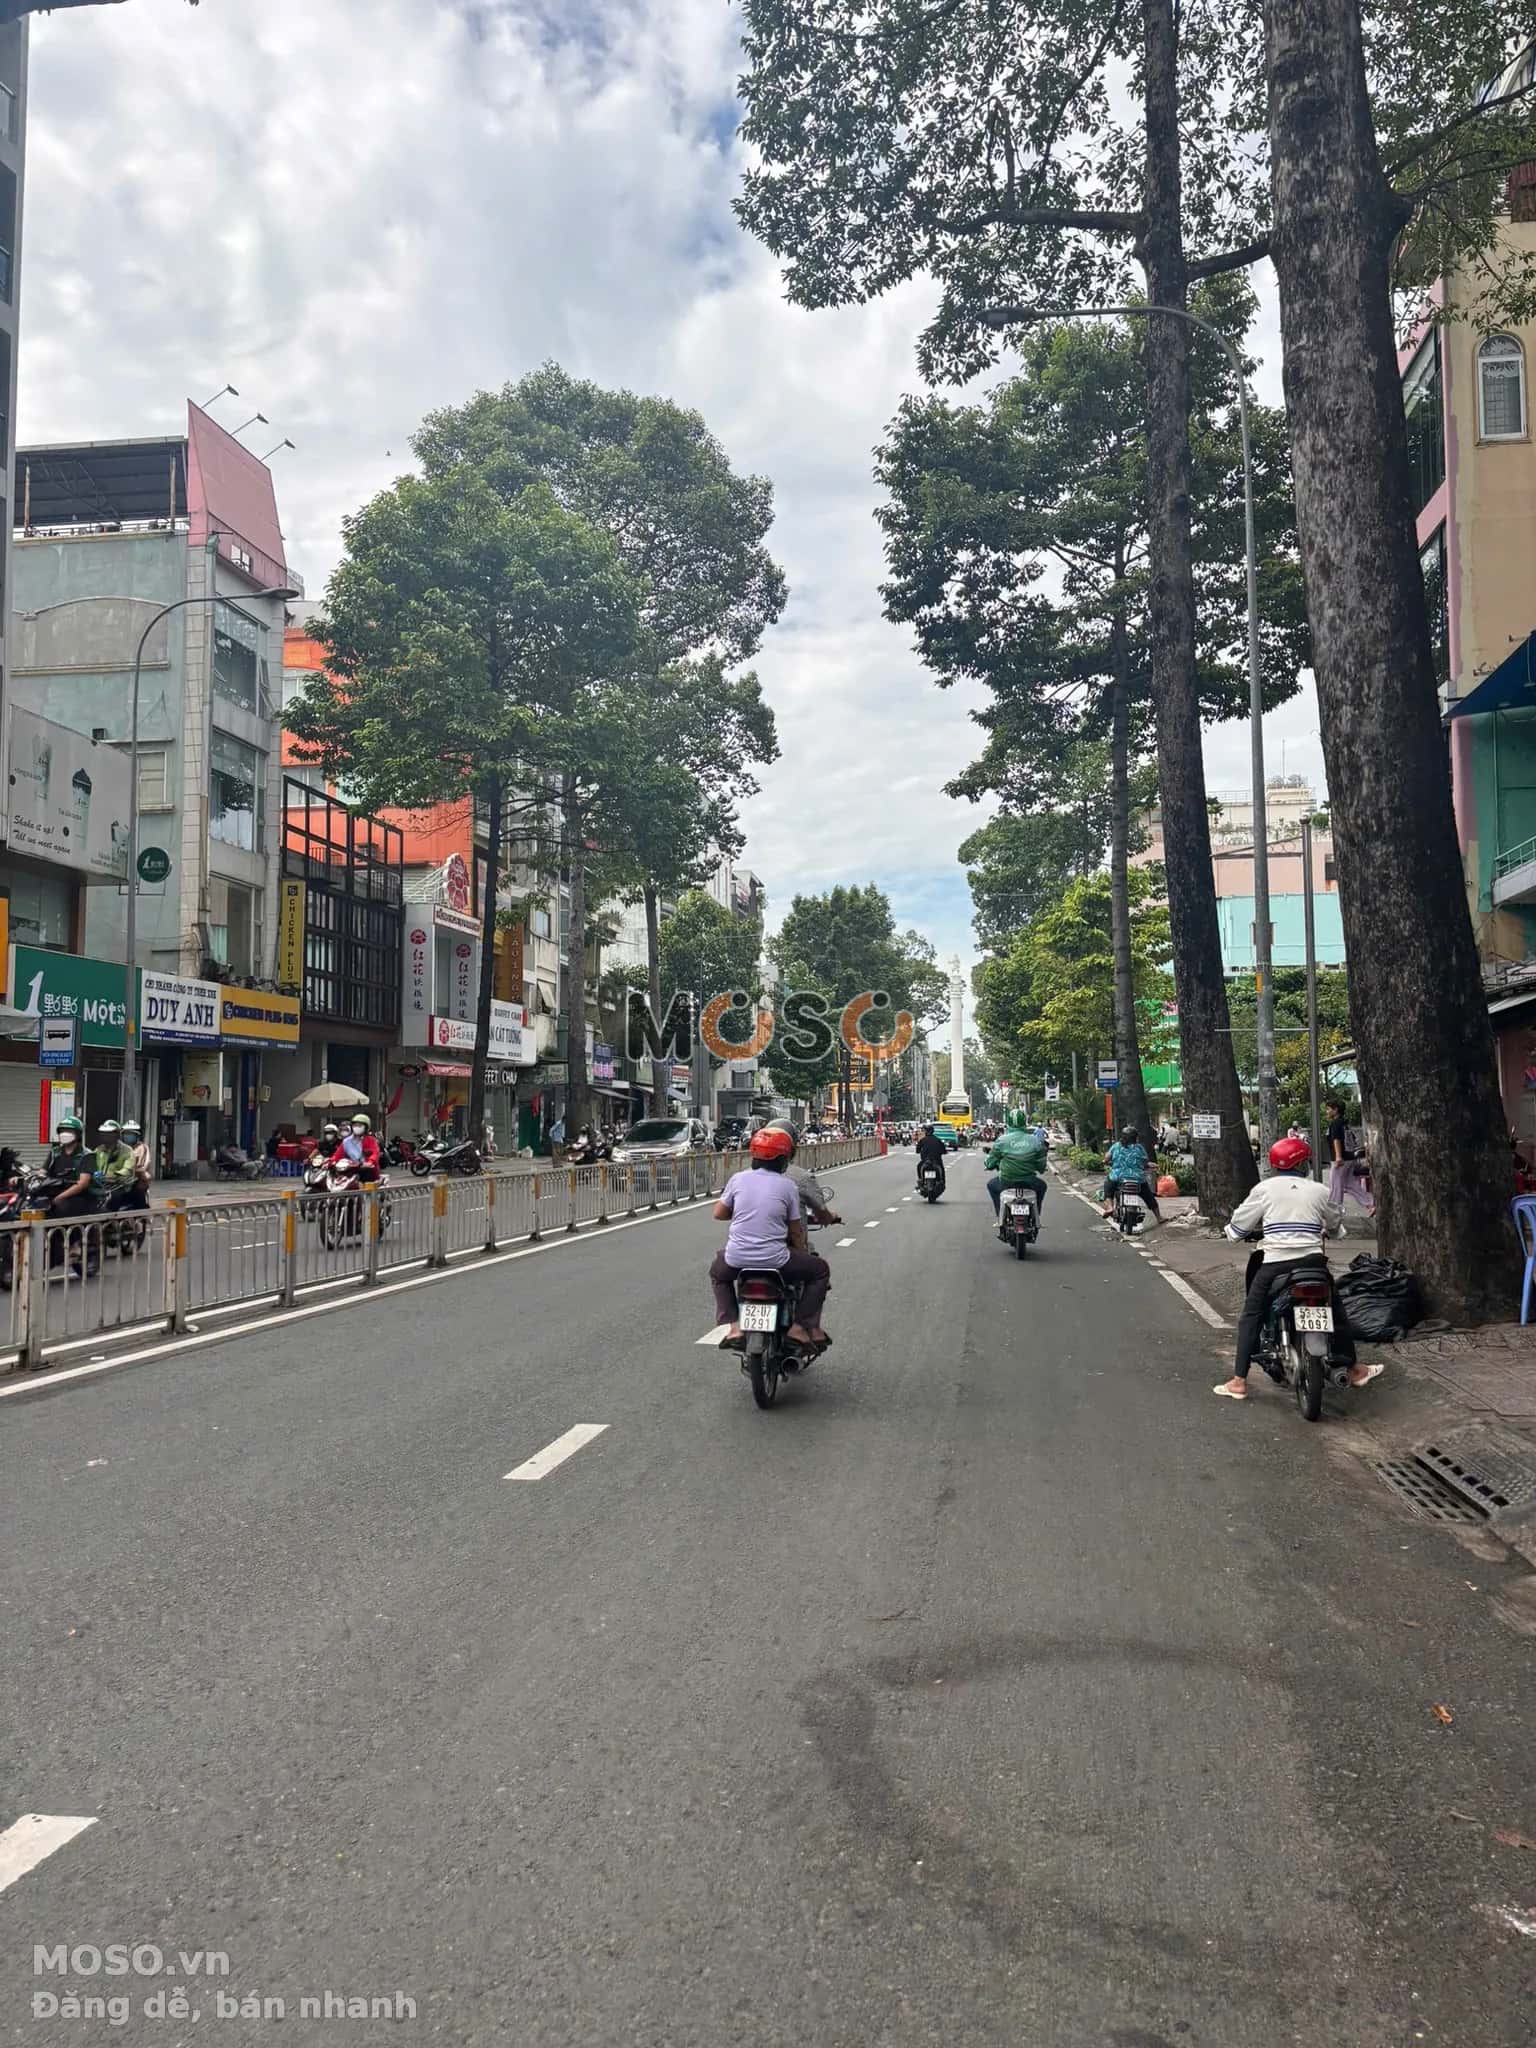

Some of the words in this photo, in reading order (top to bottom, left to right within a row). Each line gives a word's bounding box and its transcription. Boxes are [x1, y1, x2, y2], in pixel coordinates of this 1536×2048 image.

[288, 898, 296, 947] CHICKEN
[147, 997, 180, 1022] DUY
[183, 1002, 215, 1027] ANH
[744, 1317, 770, 1329] 0291
[1300, 1319, 1329, 1330] 2092
